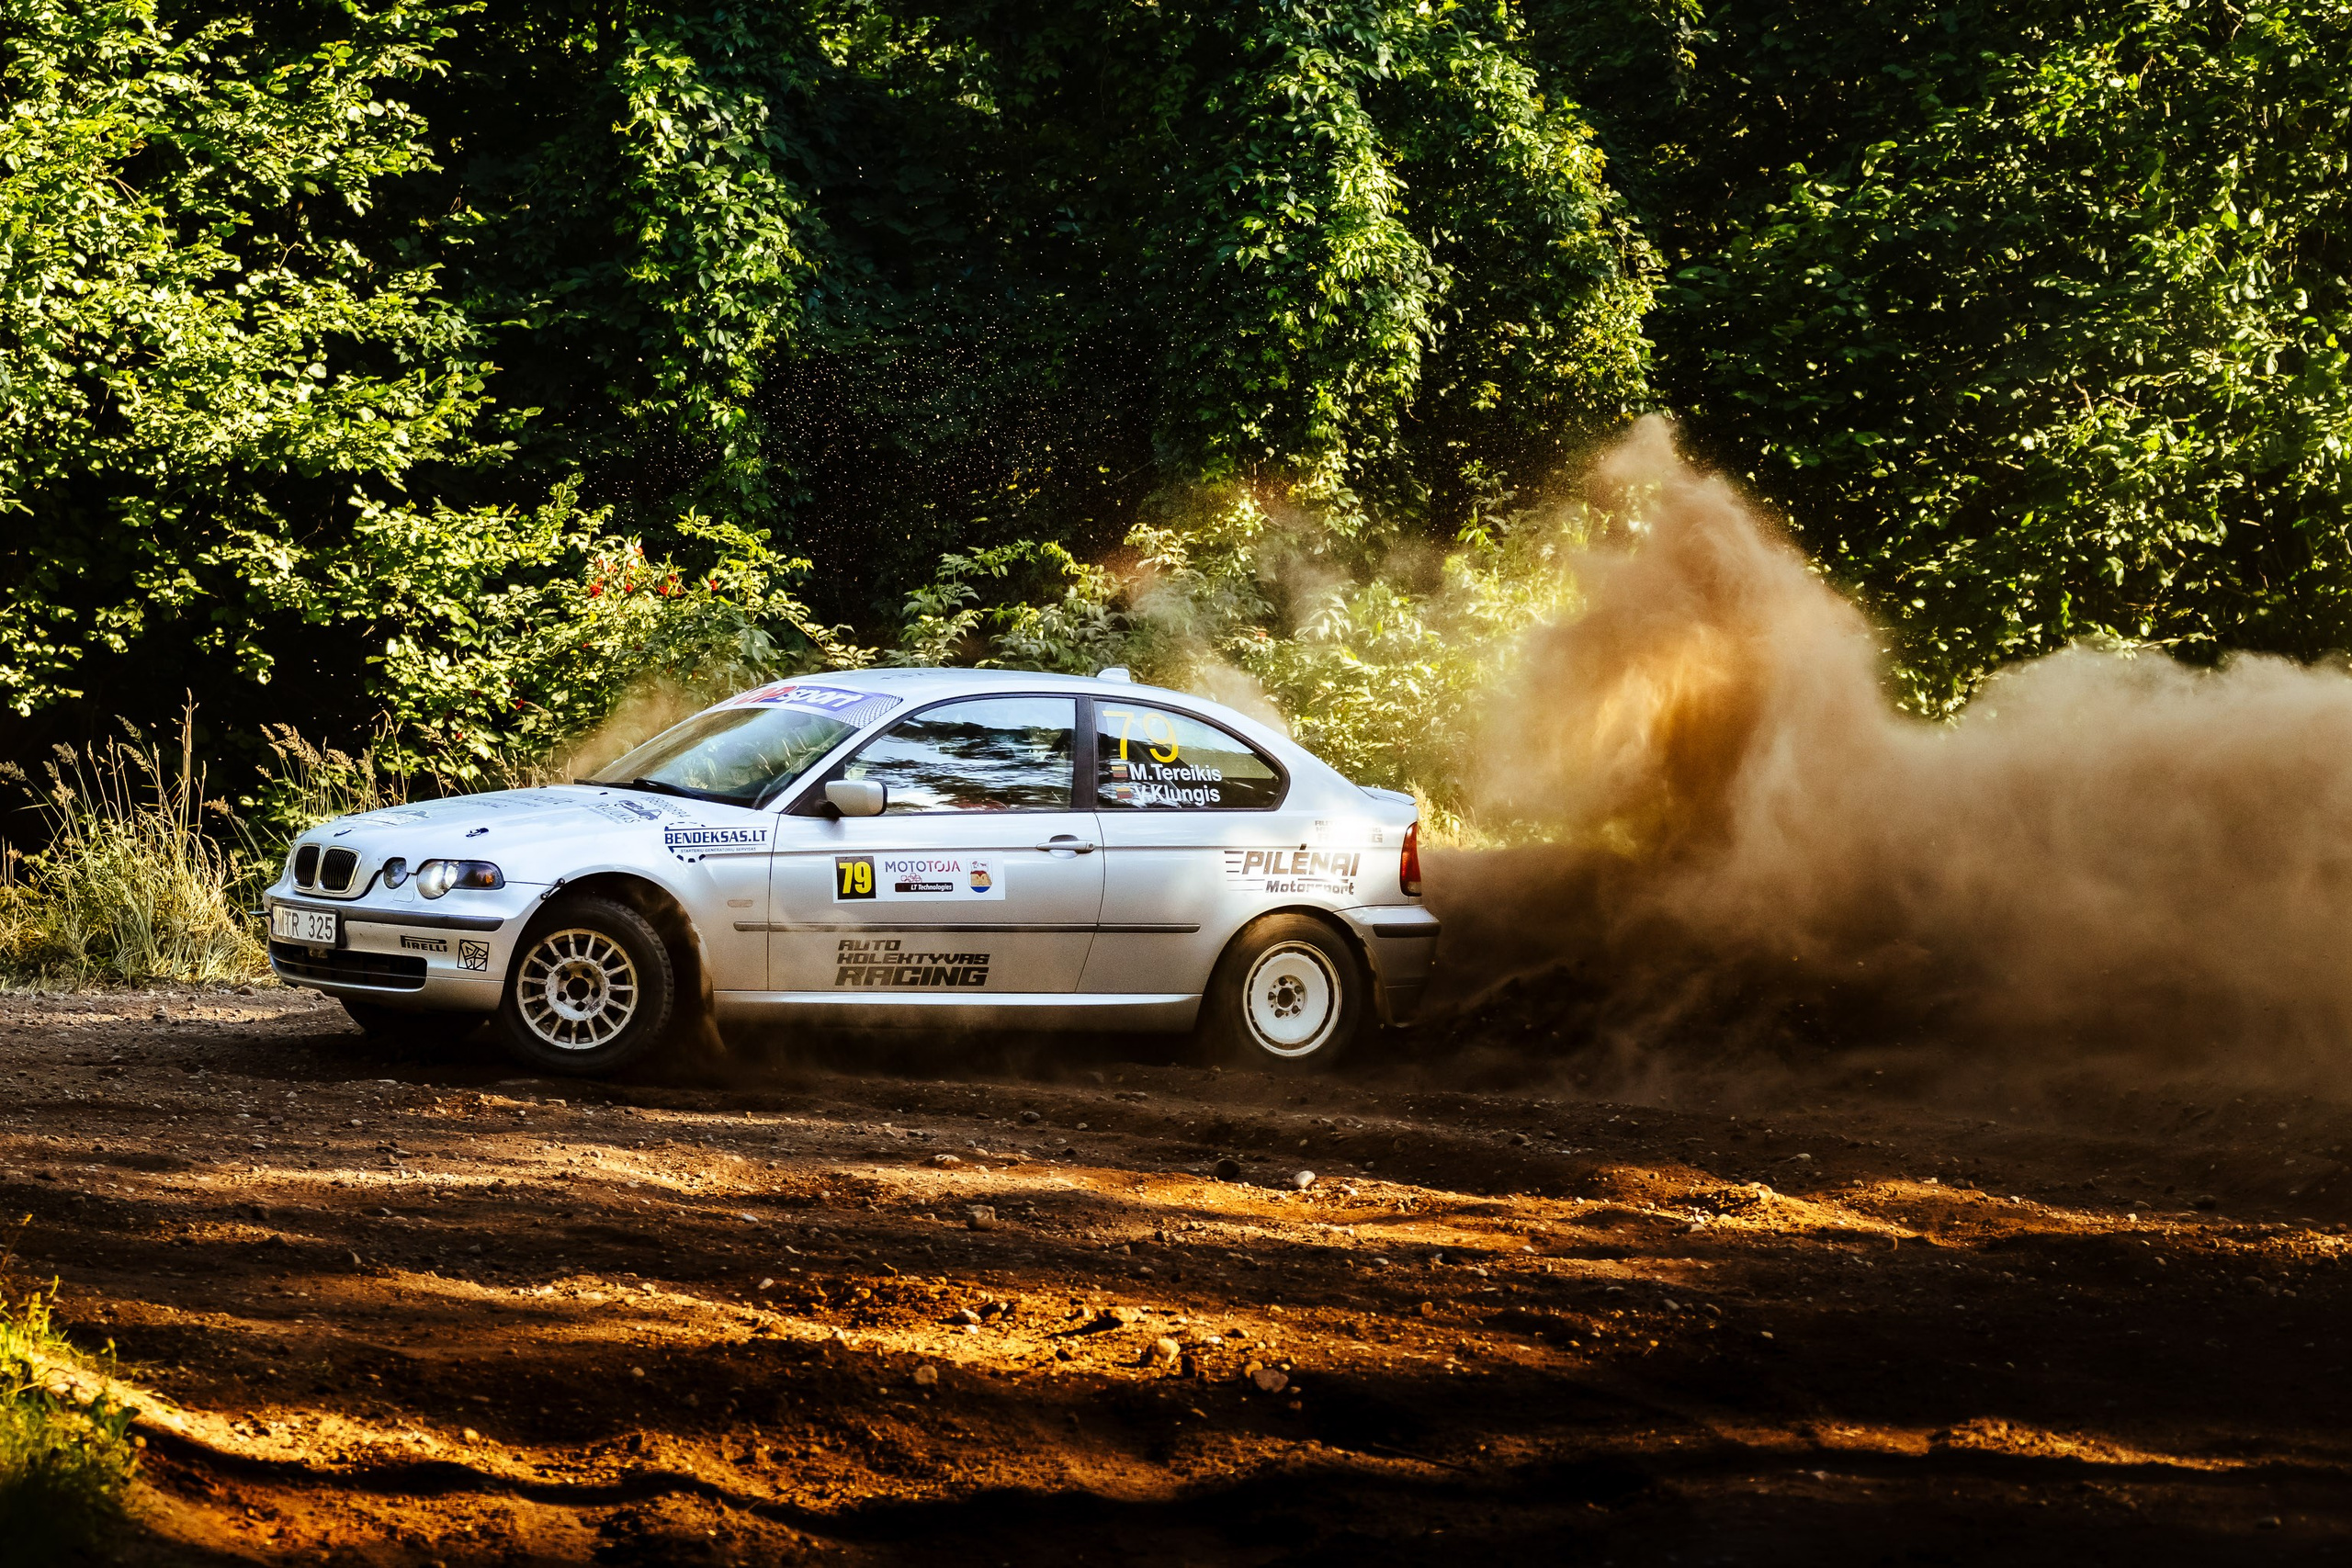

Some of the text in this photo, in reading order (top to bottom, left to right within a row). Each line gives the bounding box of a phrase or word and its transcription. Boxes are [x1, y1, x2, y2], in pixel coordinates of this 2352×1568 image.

[1102, 710, 1180, 763] 79
[664, 829, 768, 845] BENDEKSAS.LT
[885, 861, 961, 873] MOTOTOJA
[838, 861, 873, 895] 79
[919, 883, 953, 892] Technologies
[1265, 880, 1355, 896] Motorport
[308, 915, 334, 941] 325
[400, 935, 447, 953] PIRELLI
[838, 939, 901, 952] AUTO
[837, 953, 990, 965] KOLEKTYVAS
[834, 965, 990, 987] RACING
